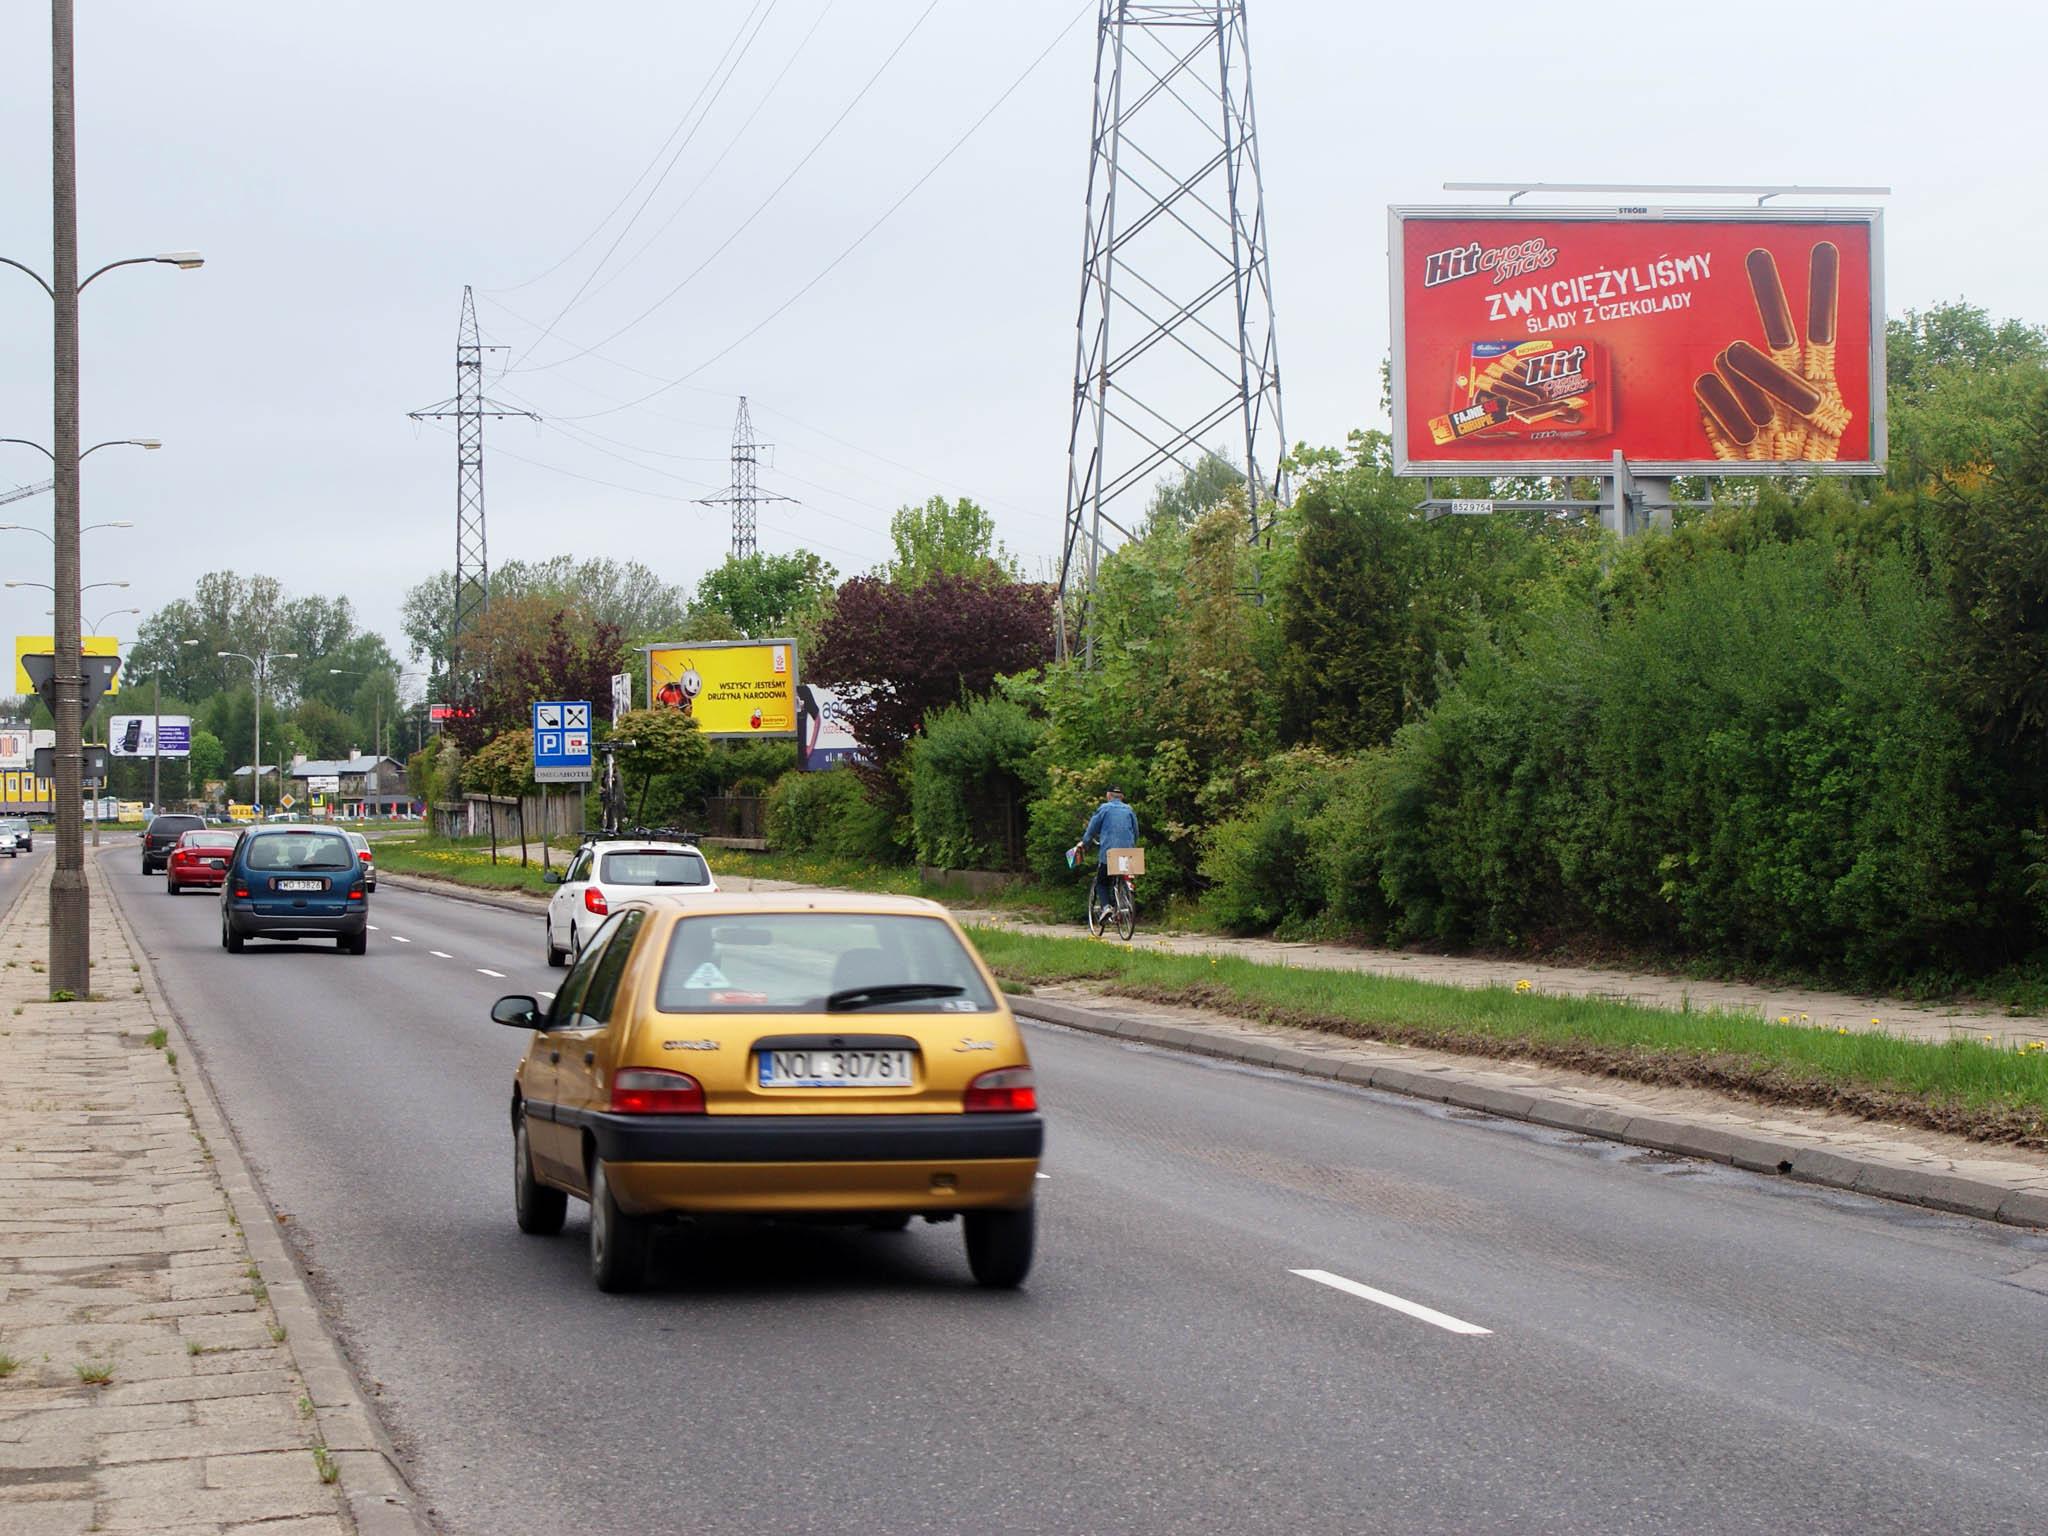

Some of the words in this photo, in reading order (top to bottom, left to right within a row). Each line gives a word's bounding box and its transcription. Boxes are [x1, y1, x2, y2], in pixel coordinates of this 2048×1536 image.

[1424, 242, 1481, 287] Hit
[1480, 237, 1545, 271] CHOCO
[1493, 248, 1558, 284] STICKS
[1485, 252, 1712, 321] ZWYCIĘŻYLIŚMY
[1526, 311, 1577, 334] ŚLADY
[1583, 308, 1595, 324] Z
[1600, 292, 1692, 321] CZEKOLADY
[1525, 345, 1587, 386] Hit
[707, 691, 741, 700] DRUŻYNĄ
[743, 691, 787, 700] NARODOWĄ
[719, 681, 752, 690] WSZYSCY
[754, 680, 786, 689] JESTEŚMY
[774, 1052, 822, 1078] NOL
[832, 1052, 906, 1078] 30781
